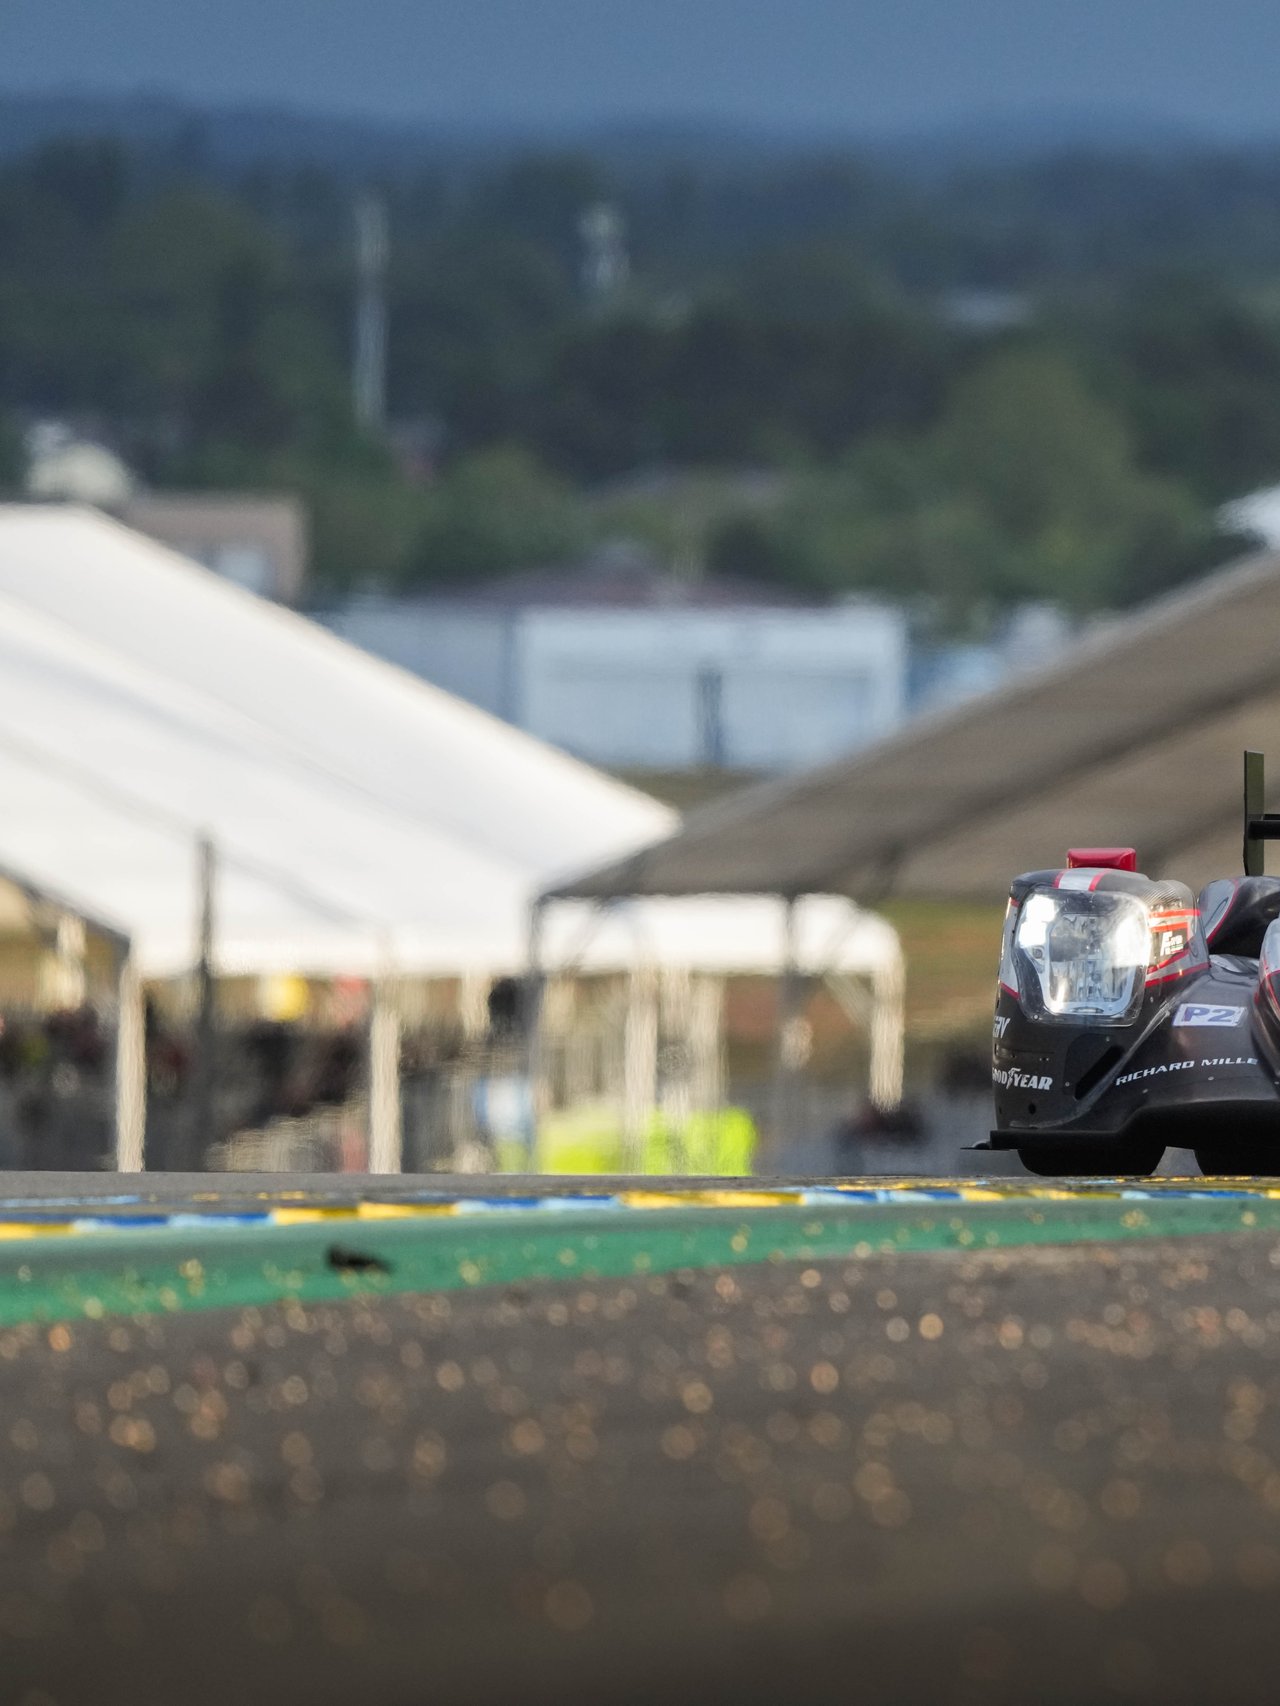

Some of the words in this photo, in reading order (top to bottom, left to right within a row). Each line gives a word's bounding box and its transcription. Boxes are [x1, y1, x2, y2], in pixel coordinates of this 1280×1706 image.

[1180, 1006, 1233, 1023] P2
[1115, 1060, 1195, 1086] RICHARD
[1201, 1056, 1258, 1066] MILLE
